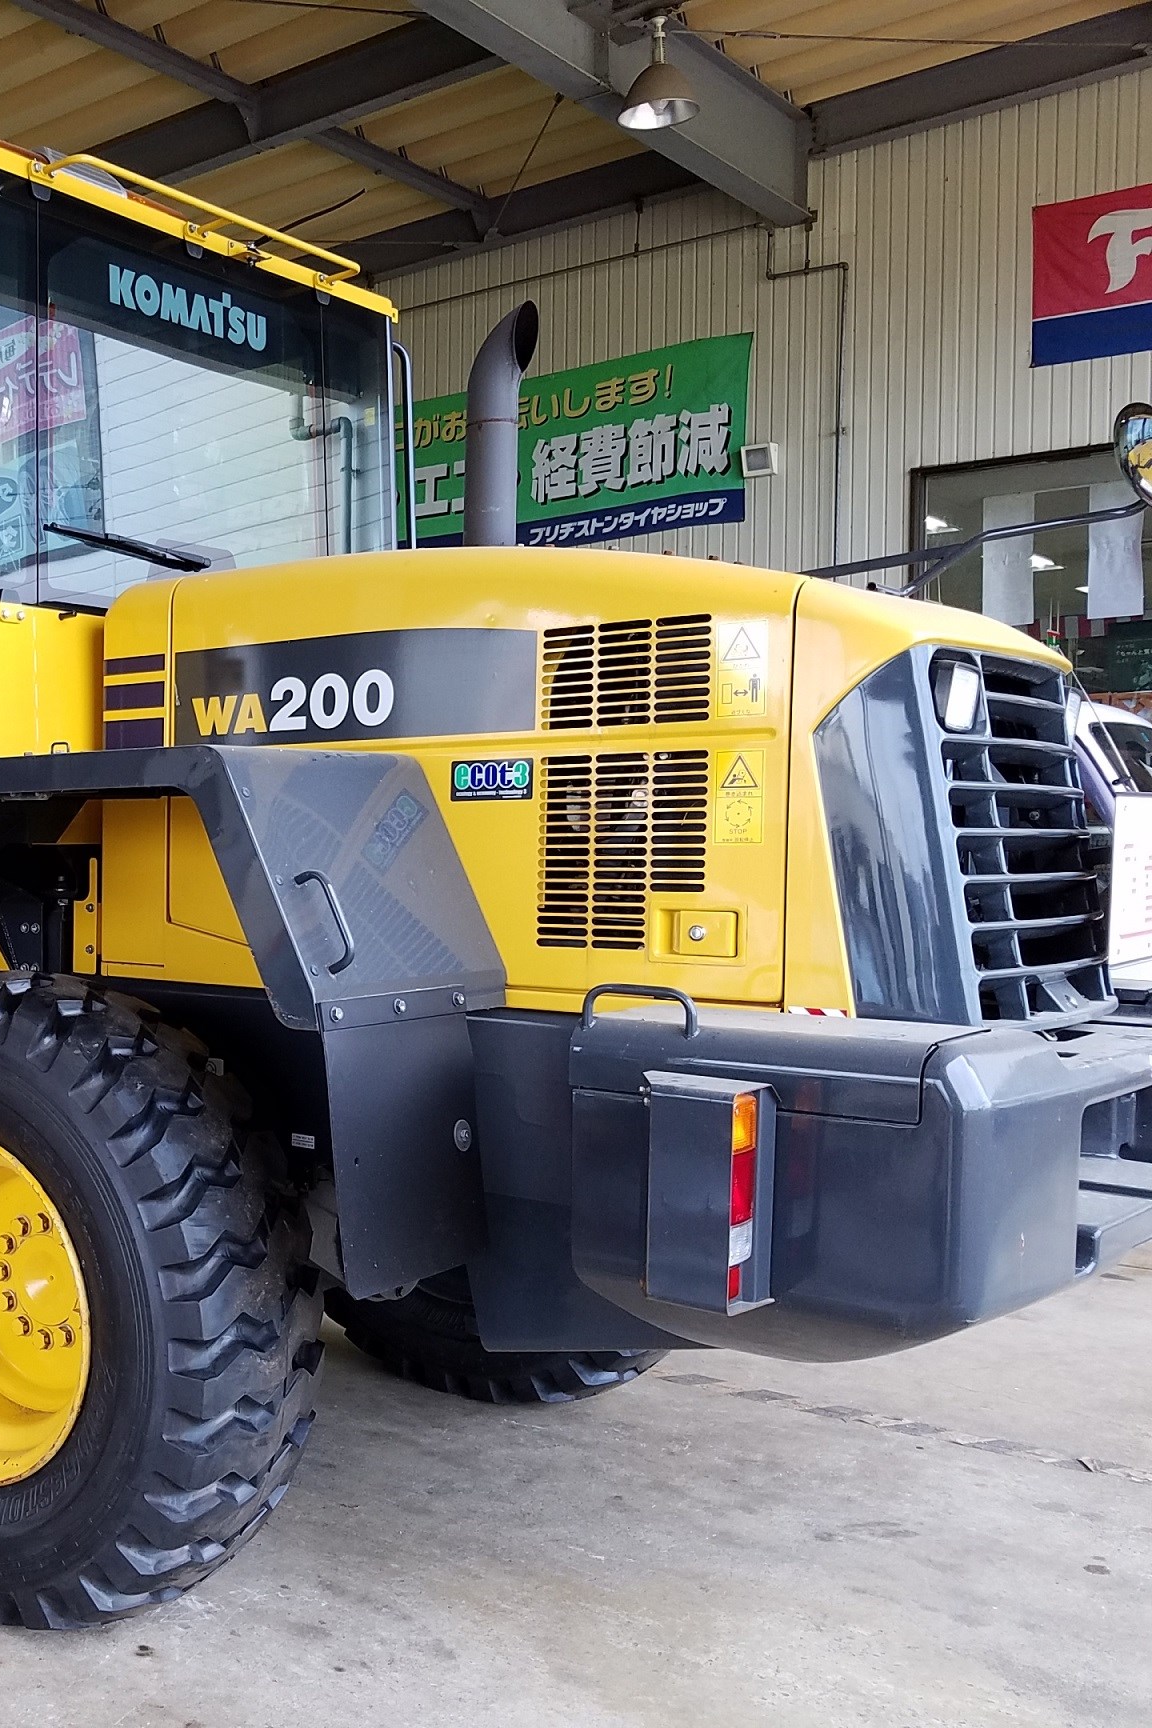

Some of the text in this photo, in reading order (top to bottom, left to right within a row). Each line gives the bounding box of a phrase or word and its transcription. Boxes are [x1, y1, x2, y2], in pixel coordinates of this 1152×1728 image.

[108, 264, 267, 352] KOMATSU
[530, 402, 732, 504] 経費節減
[528, 497, 728, 545] ブリヂストンタイヤショップ
[192, 668, 395, 738] WA200
[454, 761, 530, 790] ecot3
